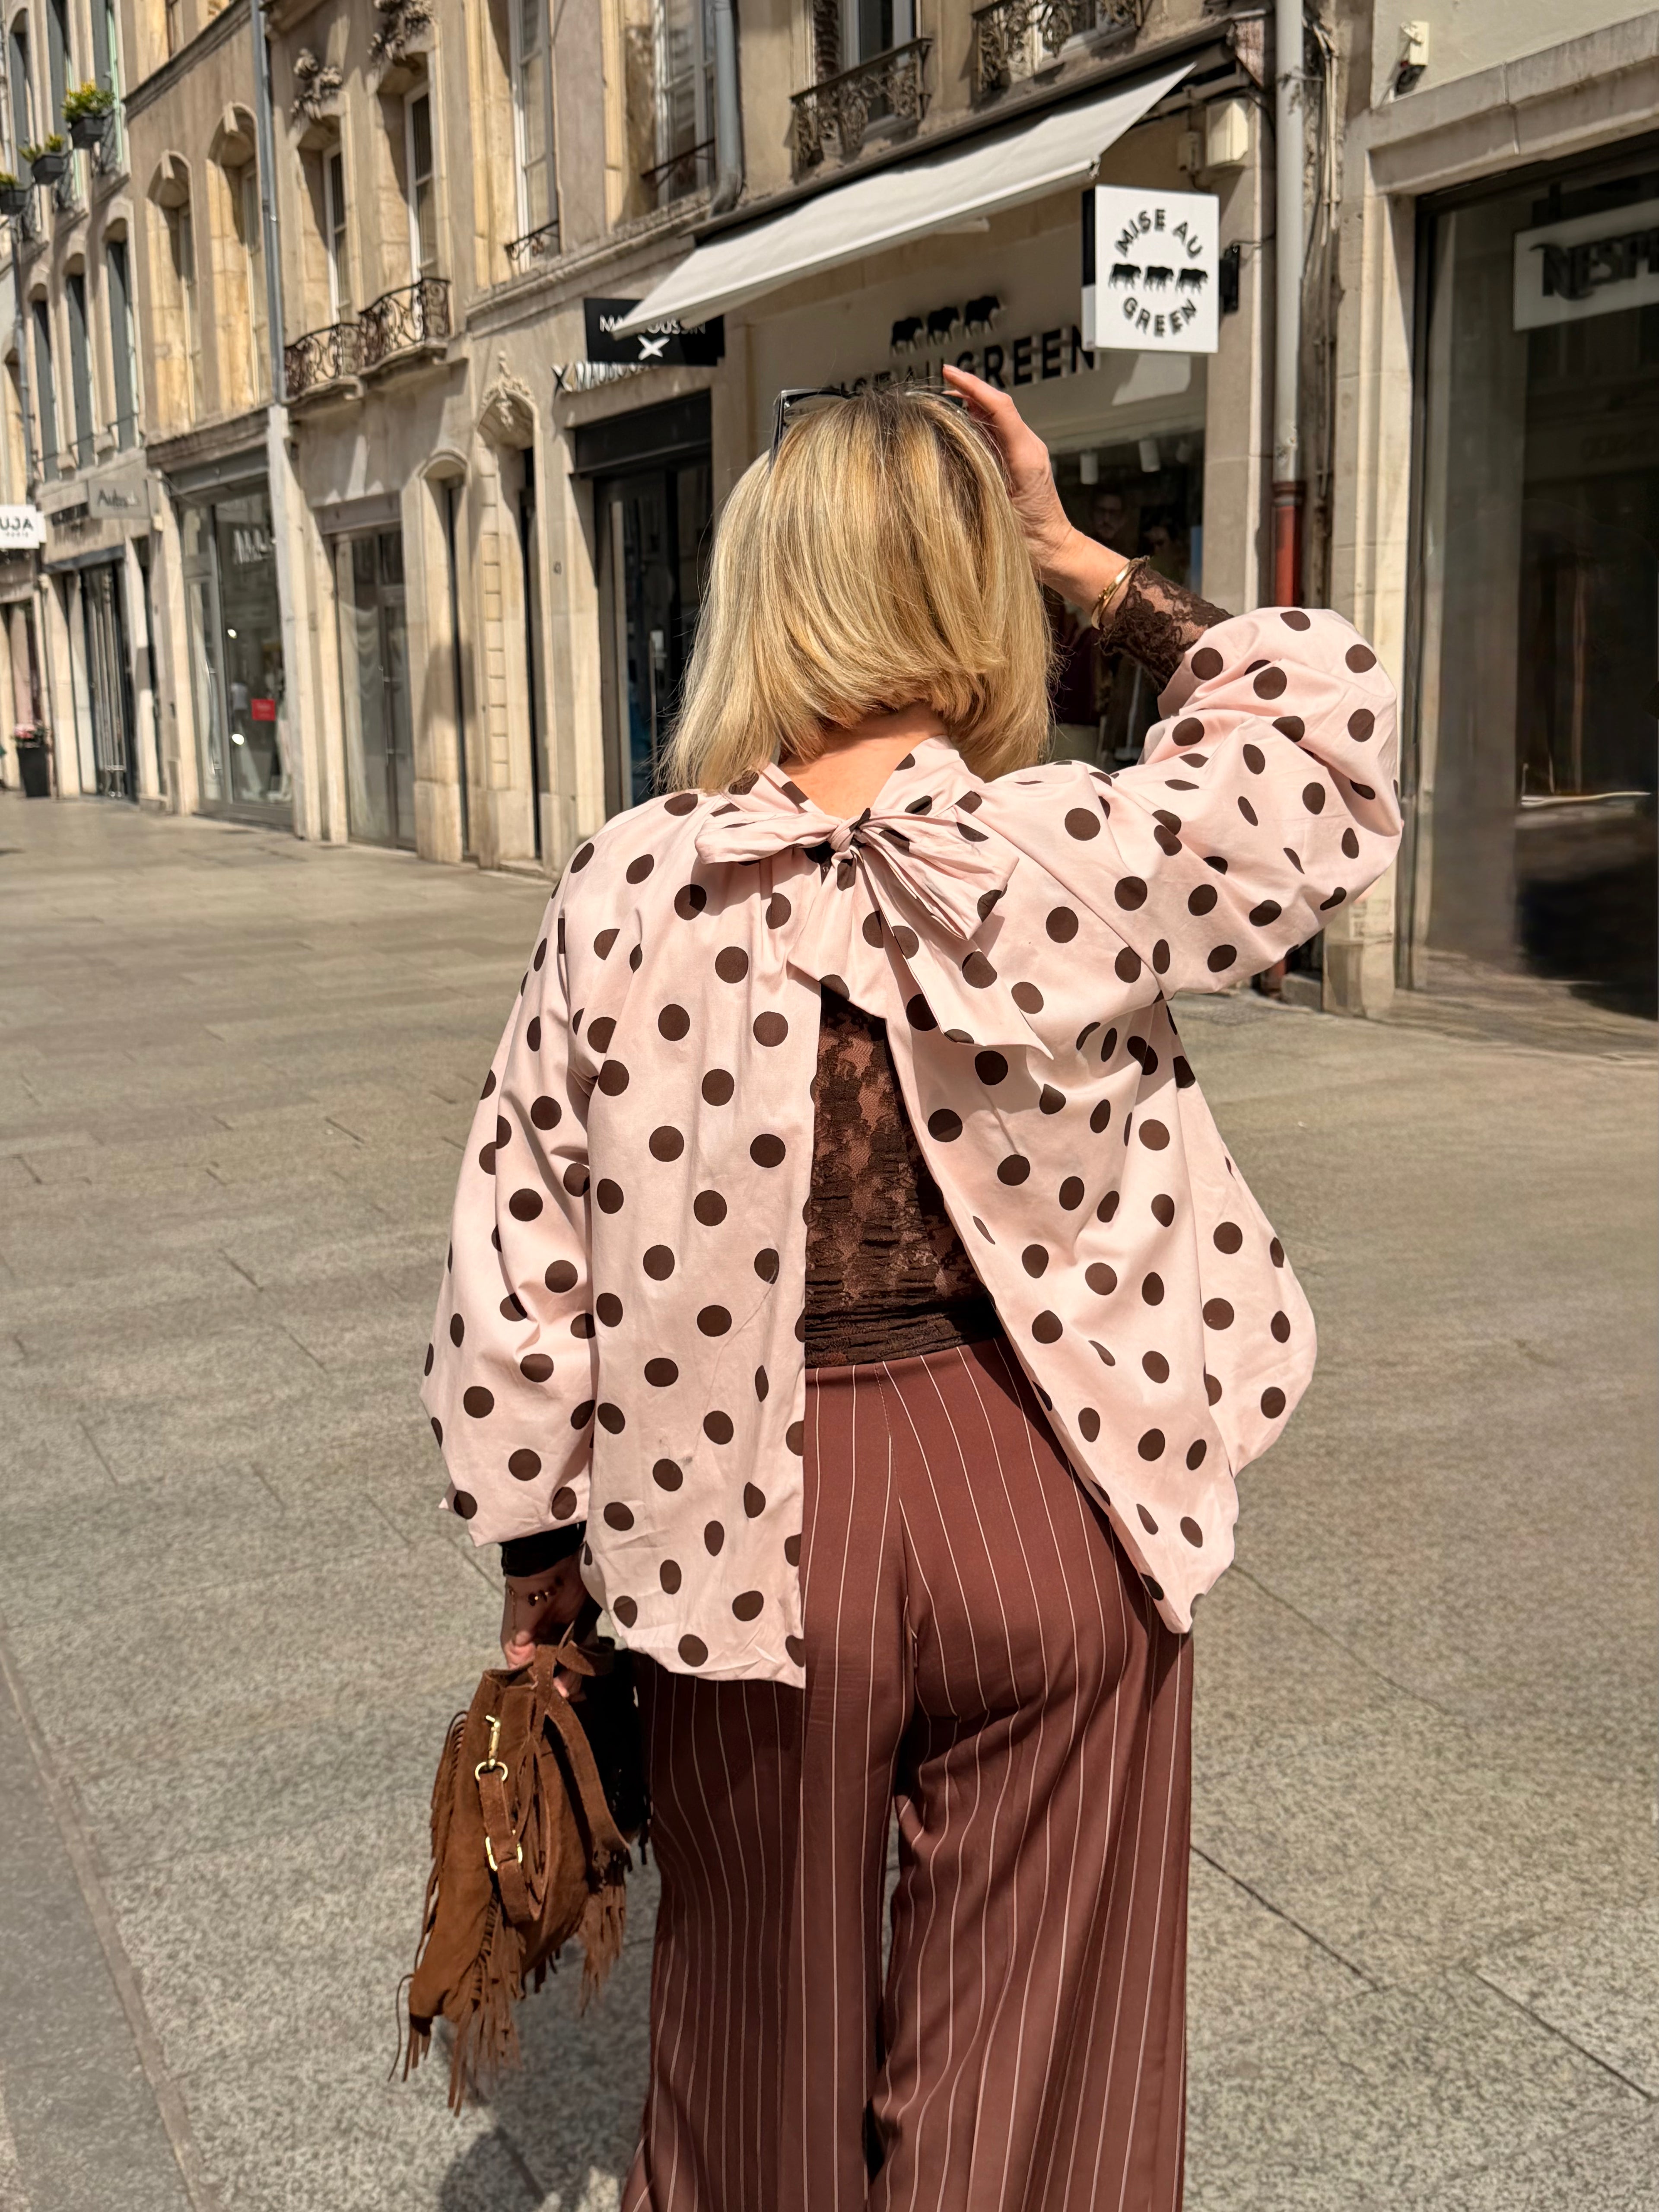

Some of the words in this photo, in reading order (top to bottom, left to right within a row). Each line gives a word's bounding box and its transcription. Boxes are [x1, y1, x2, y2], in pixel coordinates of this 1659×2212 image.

[1115, 209, 1166, 258] MISE
[1172, 221, 1203, 260] AU
[1122, 297, 1197, 337] GREEN
[956, 325, 1094, 388] GREEN
